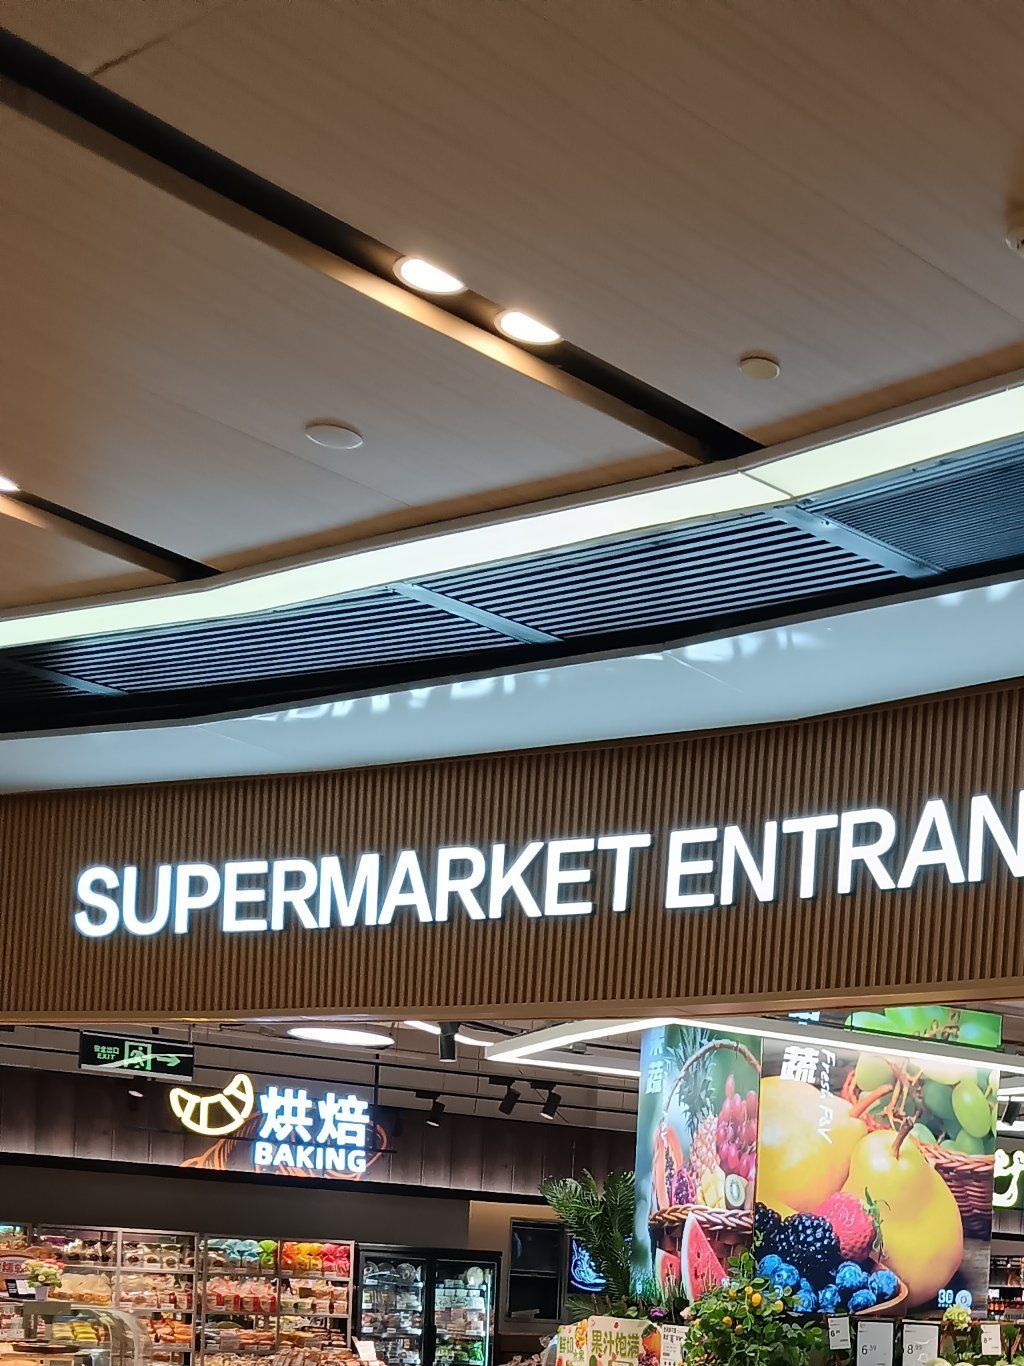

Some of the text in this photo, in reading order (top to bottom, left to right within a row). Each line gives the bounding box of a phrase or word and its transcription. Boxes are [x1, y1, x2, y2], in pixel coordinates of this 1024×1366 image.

[74, 833, 652, 938] SUPERMARKET
[259, 1086, 371, 1147] 烘焙
[254, 1140, 368, 1173] BAKING
[590, 1329, 640, 1359] 果汁饱满
